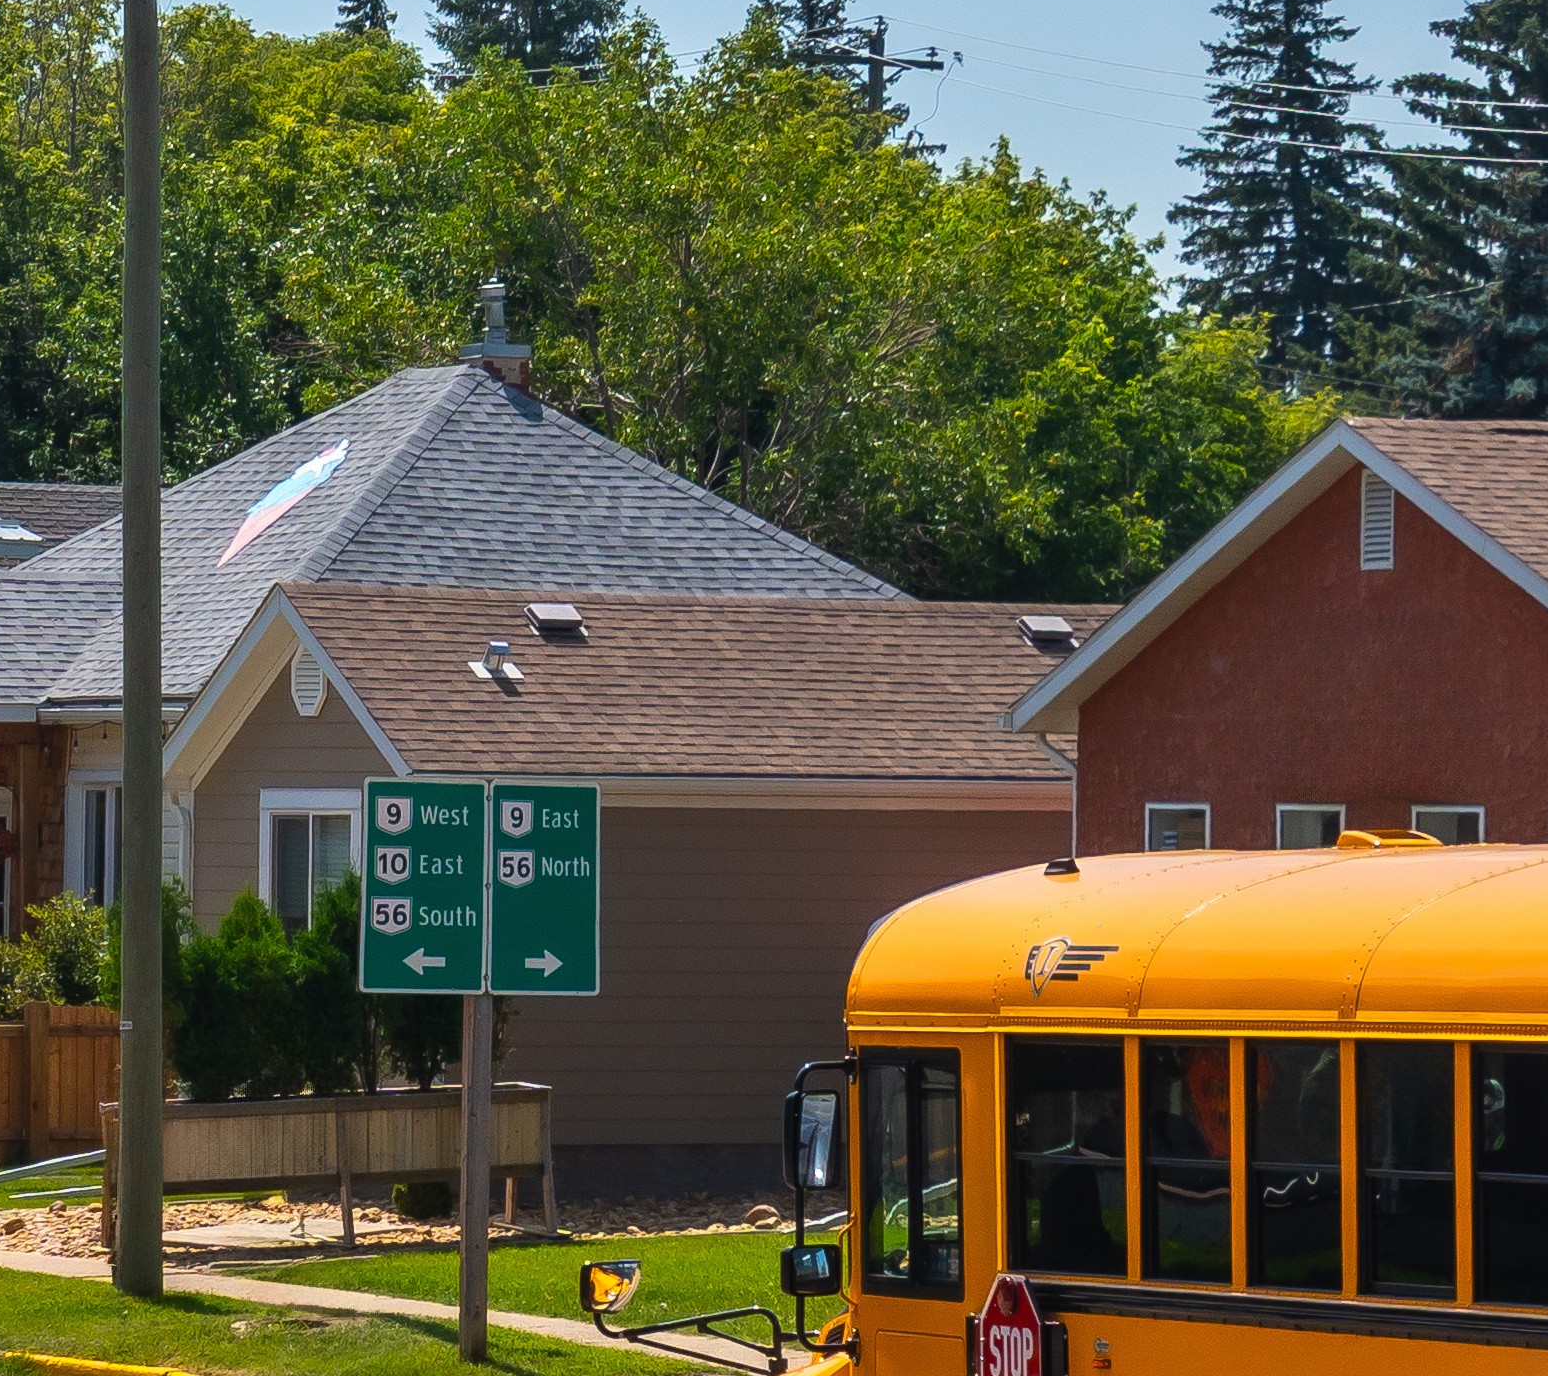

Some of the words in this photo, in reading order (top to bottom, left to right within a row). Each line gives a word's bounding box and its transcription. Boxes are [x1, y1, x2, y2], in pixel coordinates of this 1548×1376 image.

[386, 802, 402, 825] 9
[420, 805, 470, 826] West
[509, 806, 524, 829] 9
[542, 808, 579, 829] East
[378, 852, 408, 875] 10
[419, 854, 464, 875] East
[501, 856, 531, 878] 56
[541, 856, 590, 877] North
[375, 903, 408, 926] 56
[418, 906, 477, 927] South
